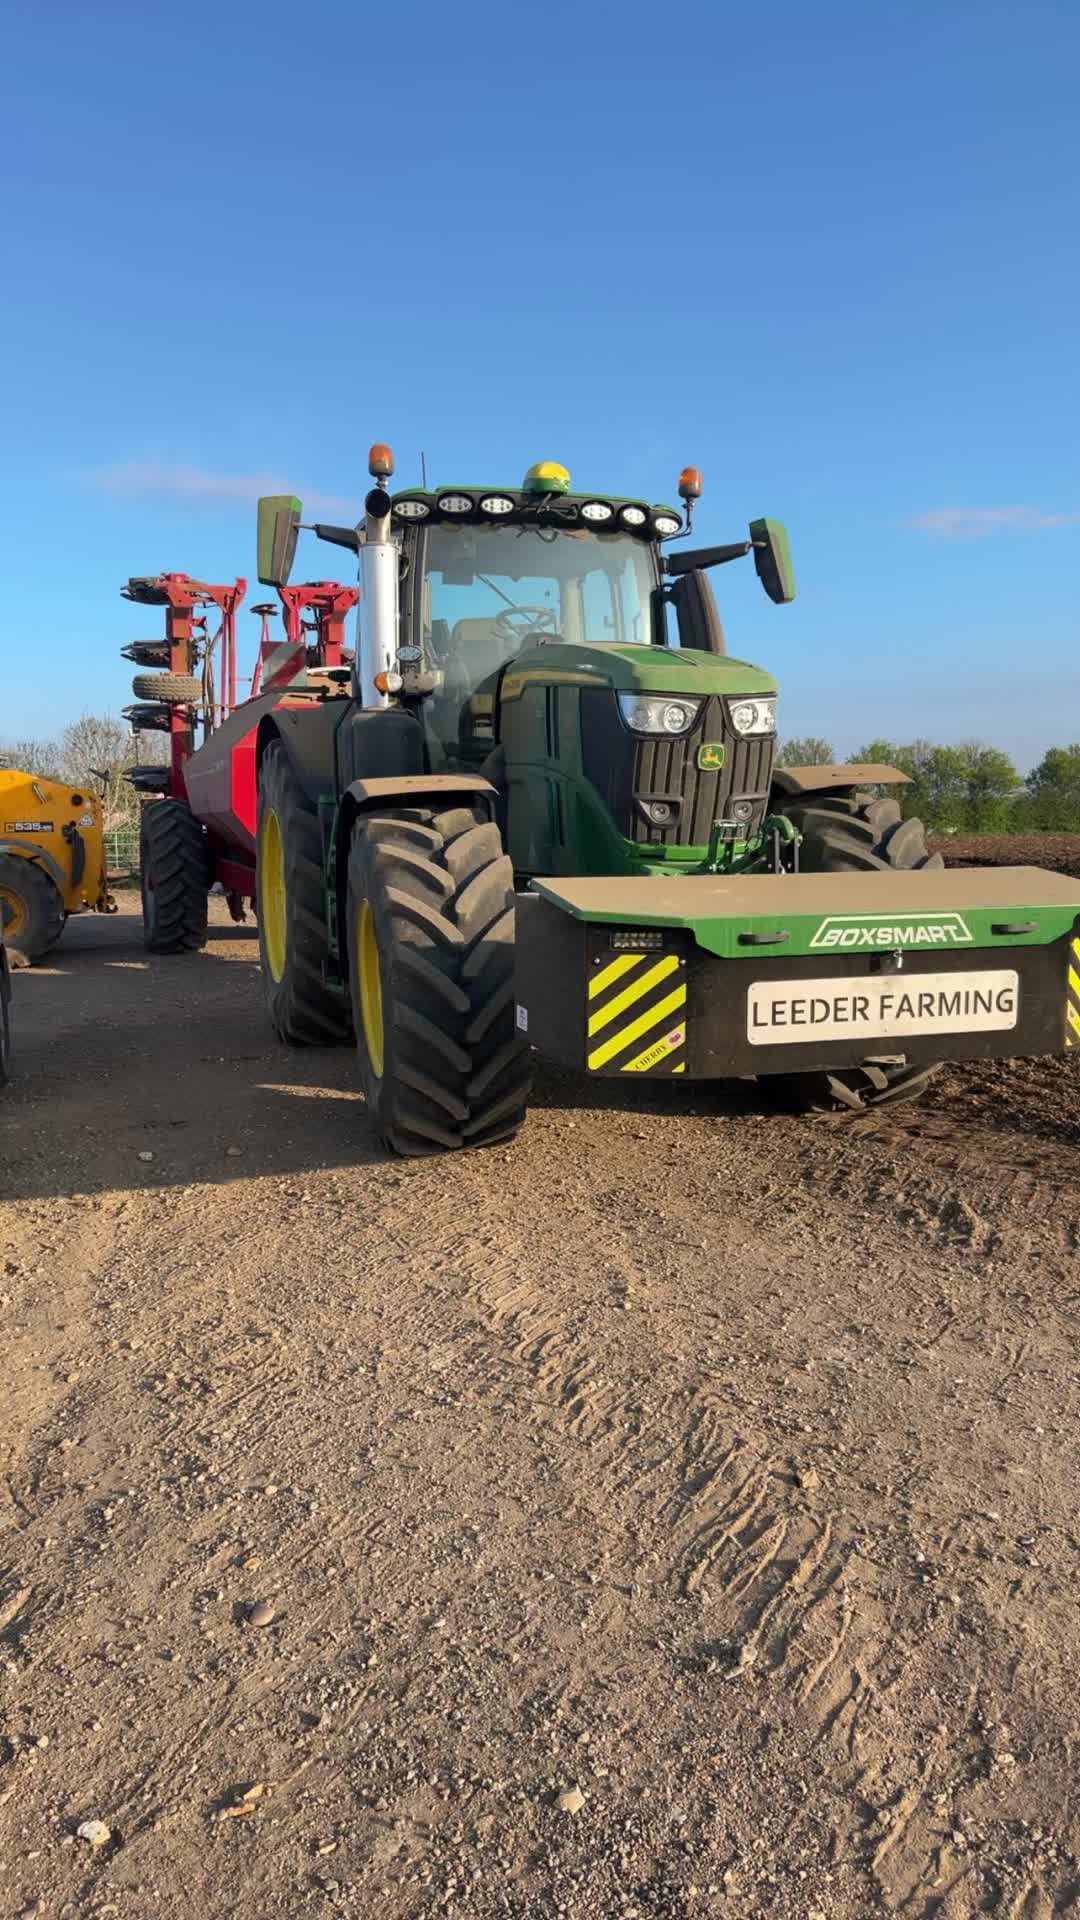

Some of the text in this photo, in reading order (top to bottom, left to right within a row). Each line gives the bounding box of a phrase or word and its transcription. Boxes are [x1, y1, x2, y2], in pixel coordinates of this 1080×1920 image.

[820, 924, 958, 947] BOXSMART
[752, 988, 1014, 1027] LEEDER FARMING
[634, 1045, 667, 1070] CHERRY
